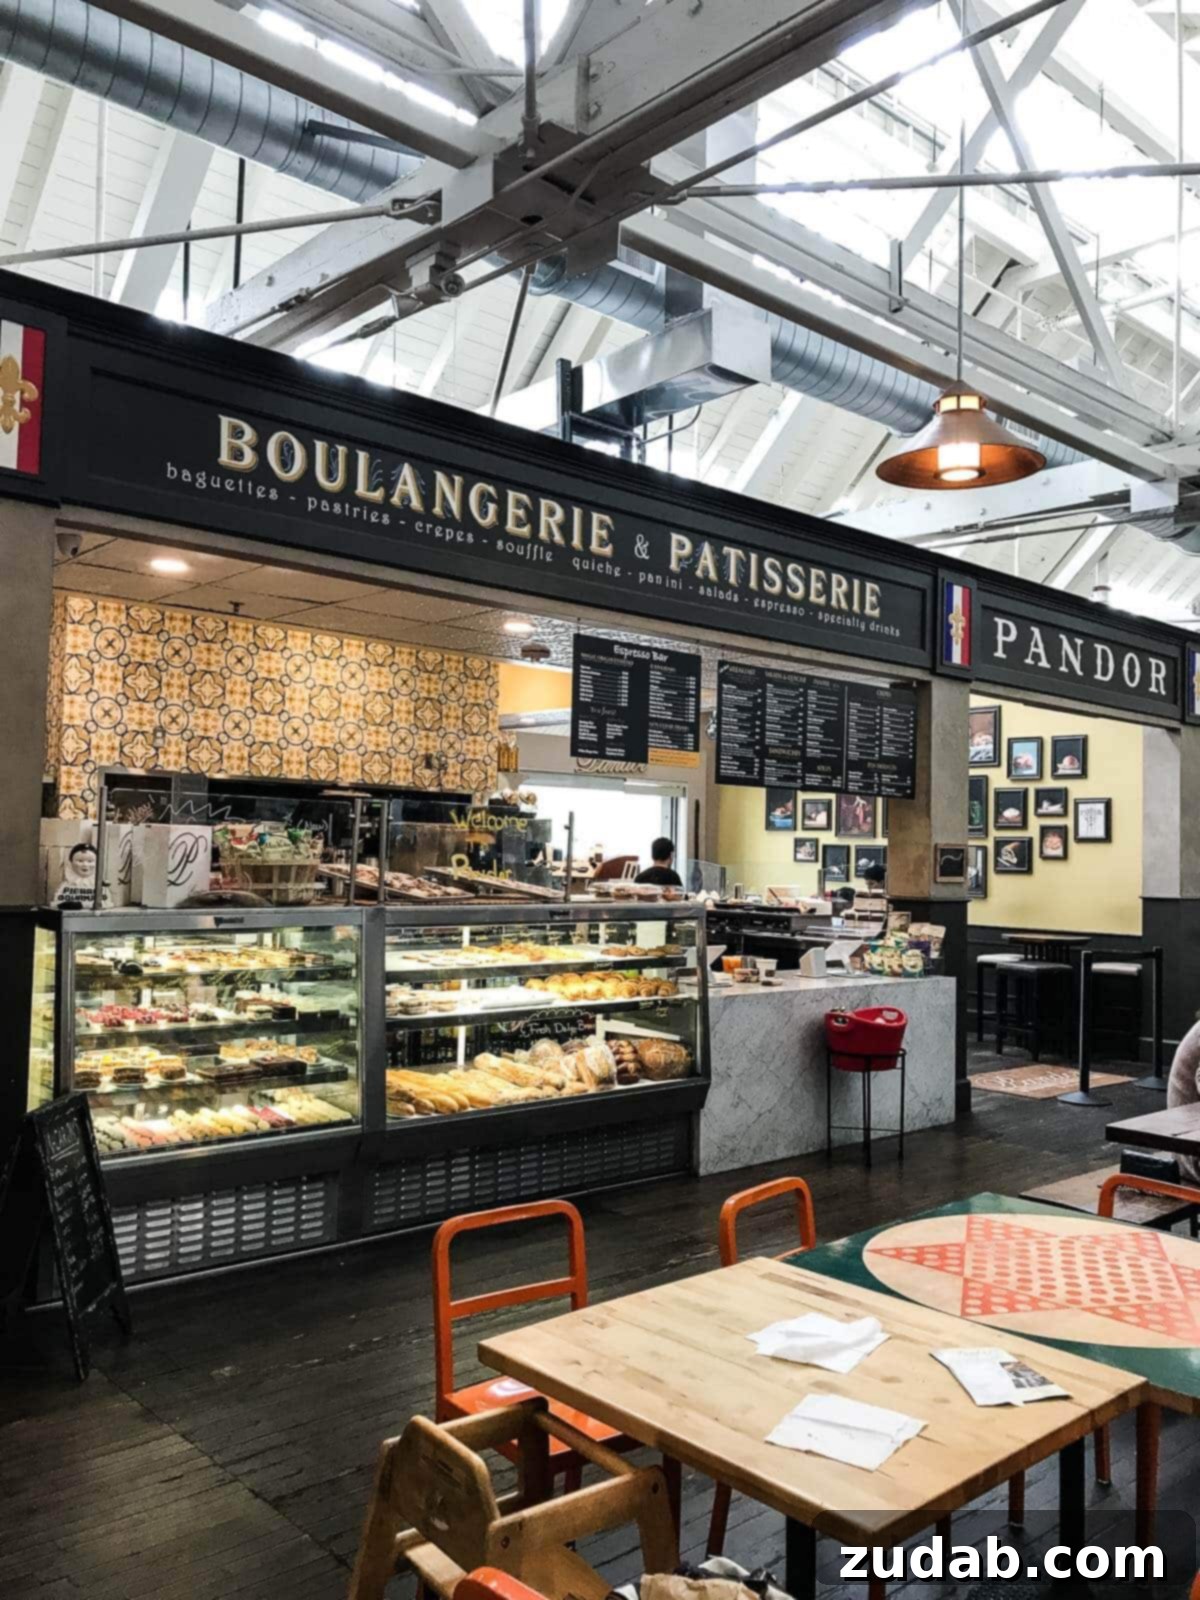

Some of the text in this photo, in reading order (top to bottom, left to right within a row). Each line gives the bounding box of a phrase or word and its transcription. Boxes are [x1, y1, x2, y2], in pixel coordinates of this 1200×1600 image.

[166, 462, 901, 637] baguettes pastries crepes souffle quiche panini salads espresso specialty drinks
[217, 414, 882, 618] BOULANGERIE & PATISSERIE
[613, 645, 670, 663] Espresso Bar
[993, 617, 1167, 696] PANDOR
[449, 808, 528, 833] Welcome
